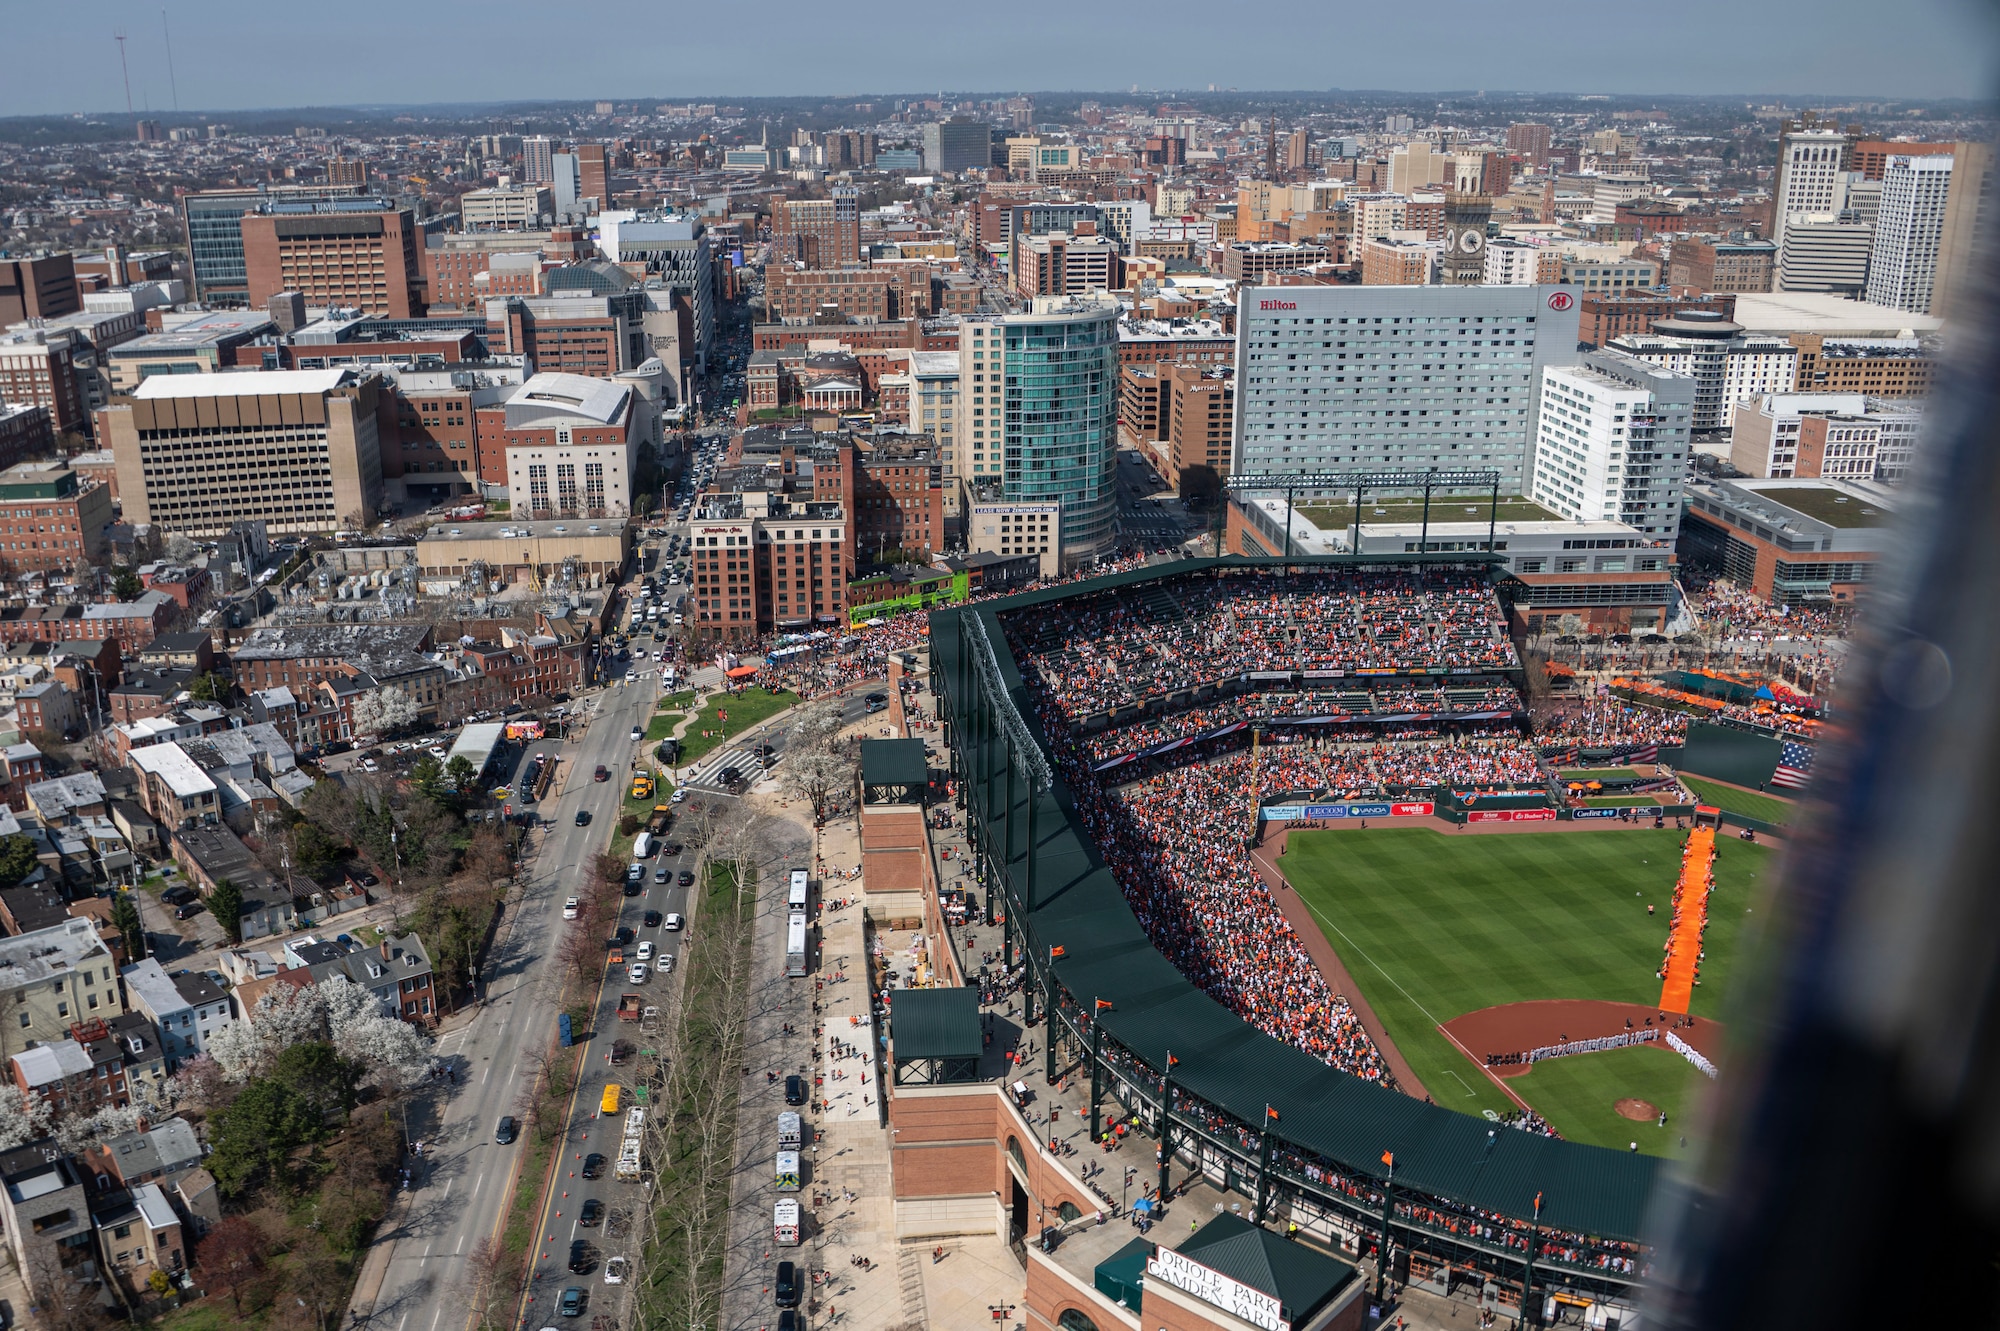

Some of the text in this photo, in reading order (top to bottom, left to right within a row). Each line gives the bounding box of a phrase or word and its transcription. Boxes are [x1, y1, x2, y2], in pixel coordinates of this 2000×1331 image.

[316, 202, 338, 211] UMB
[1260, 300, 1297, 310] Hilton
[1775, 685, 1821, 709] Coors
[1401, 804, 1424, 812] weis
[1149, 1261, 1224, 1305] CAMDEN
[1162, 1251, 1278, 1316] ORIOLE PARK
